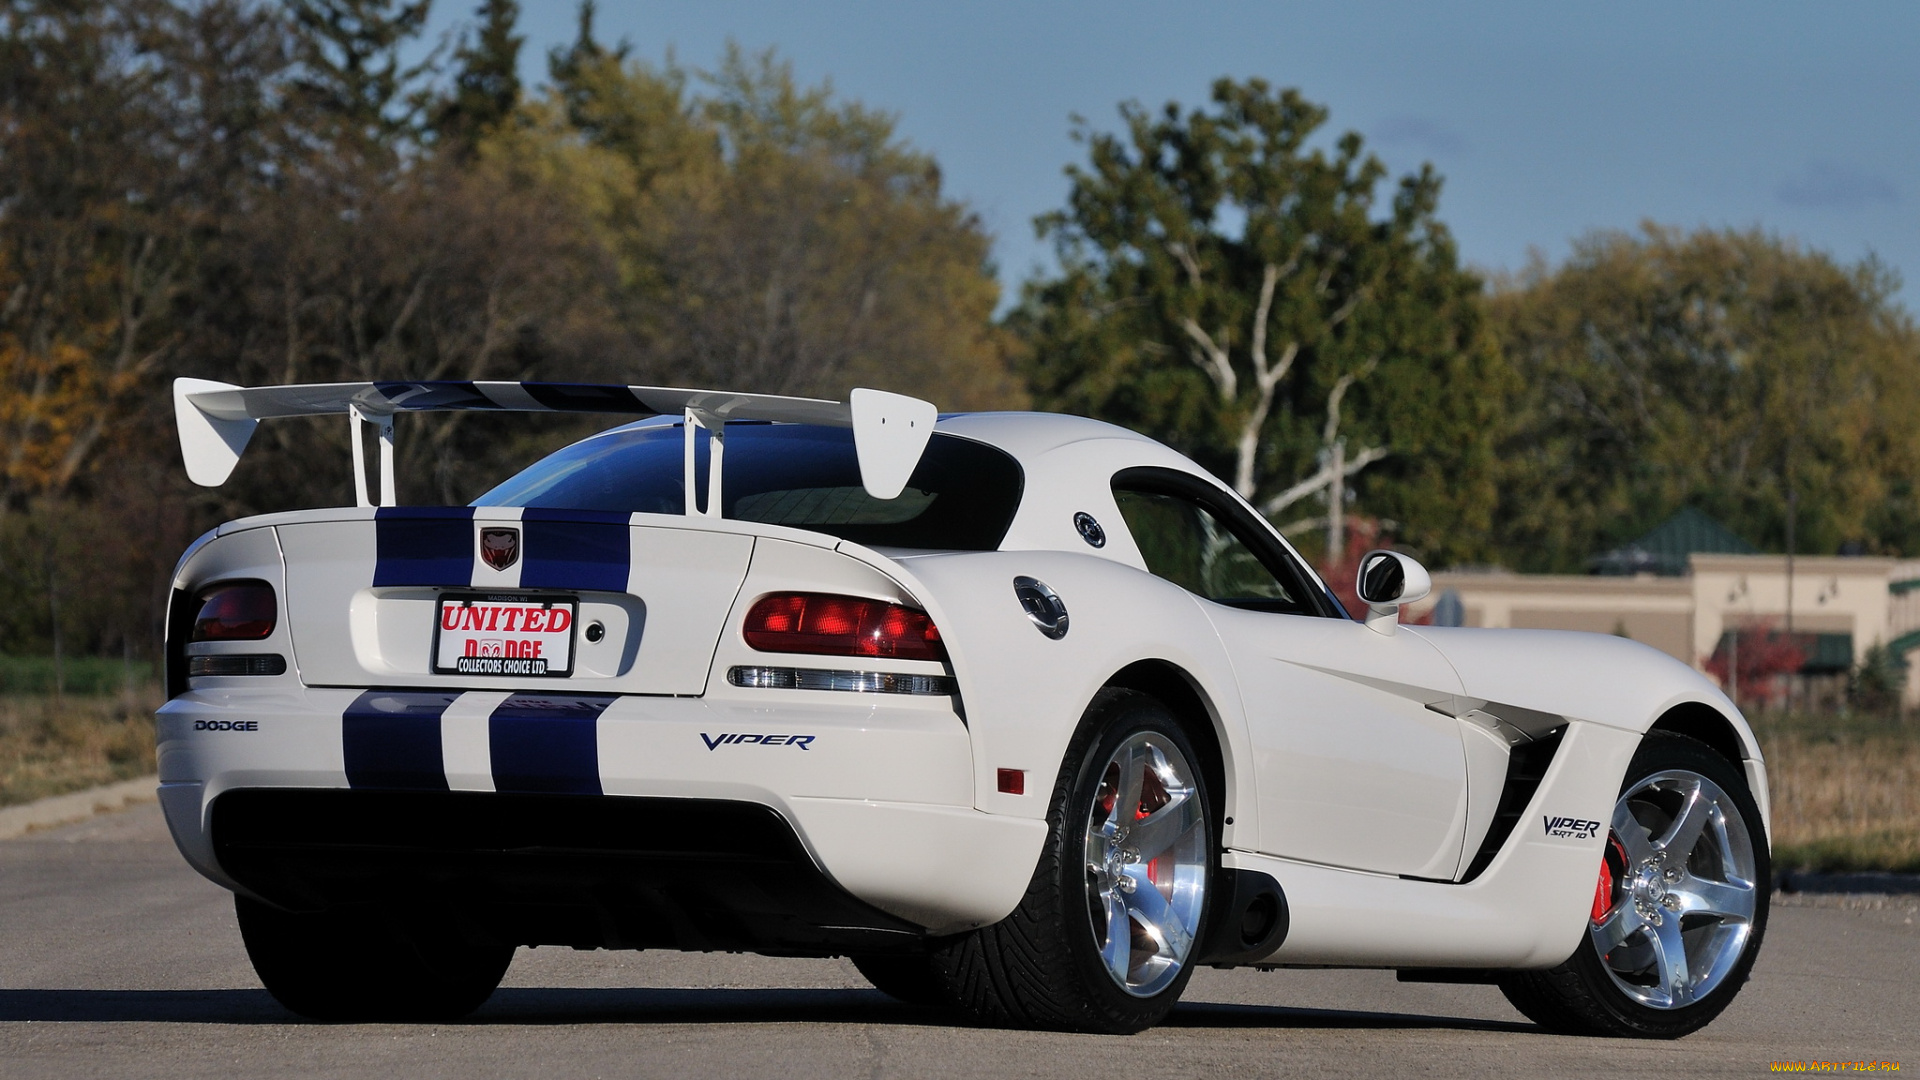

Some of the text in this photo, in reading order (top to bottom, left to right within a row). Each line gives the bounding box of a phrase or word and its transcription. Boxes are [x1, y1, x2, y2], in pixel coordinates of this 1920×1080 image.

[442, 606, 572, 632] UNITED
[458, 658, 547, 675] COLLECTORS CHOICE LTD.
[193, 720, 258, 731] DODGE
[700, 733, 816, 751] VIPER
[1543, 815, 1600, 837] VIPER
[1550, 830, 1574, 838] SRT
